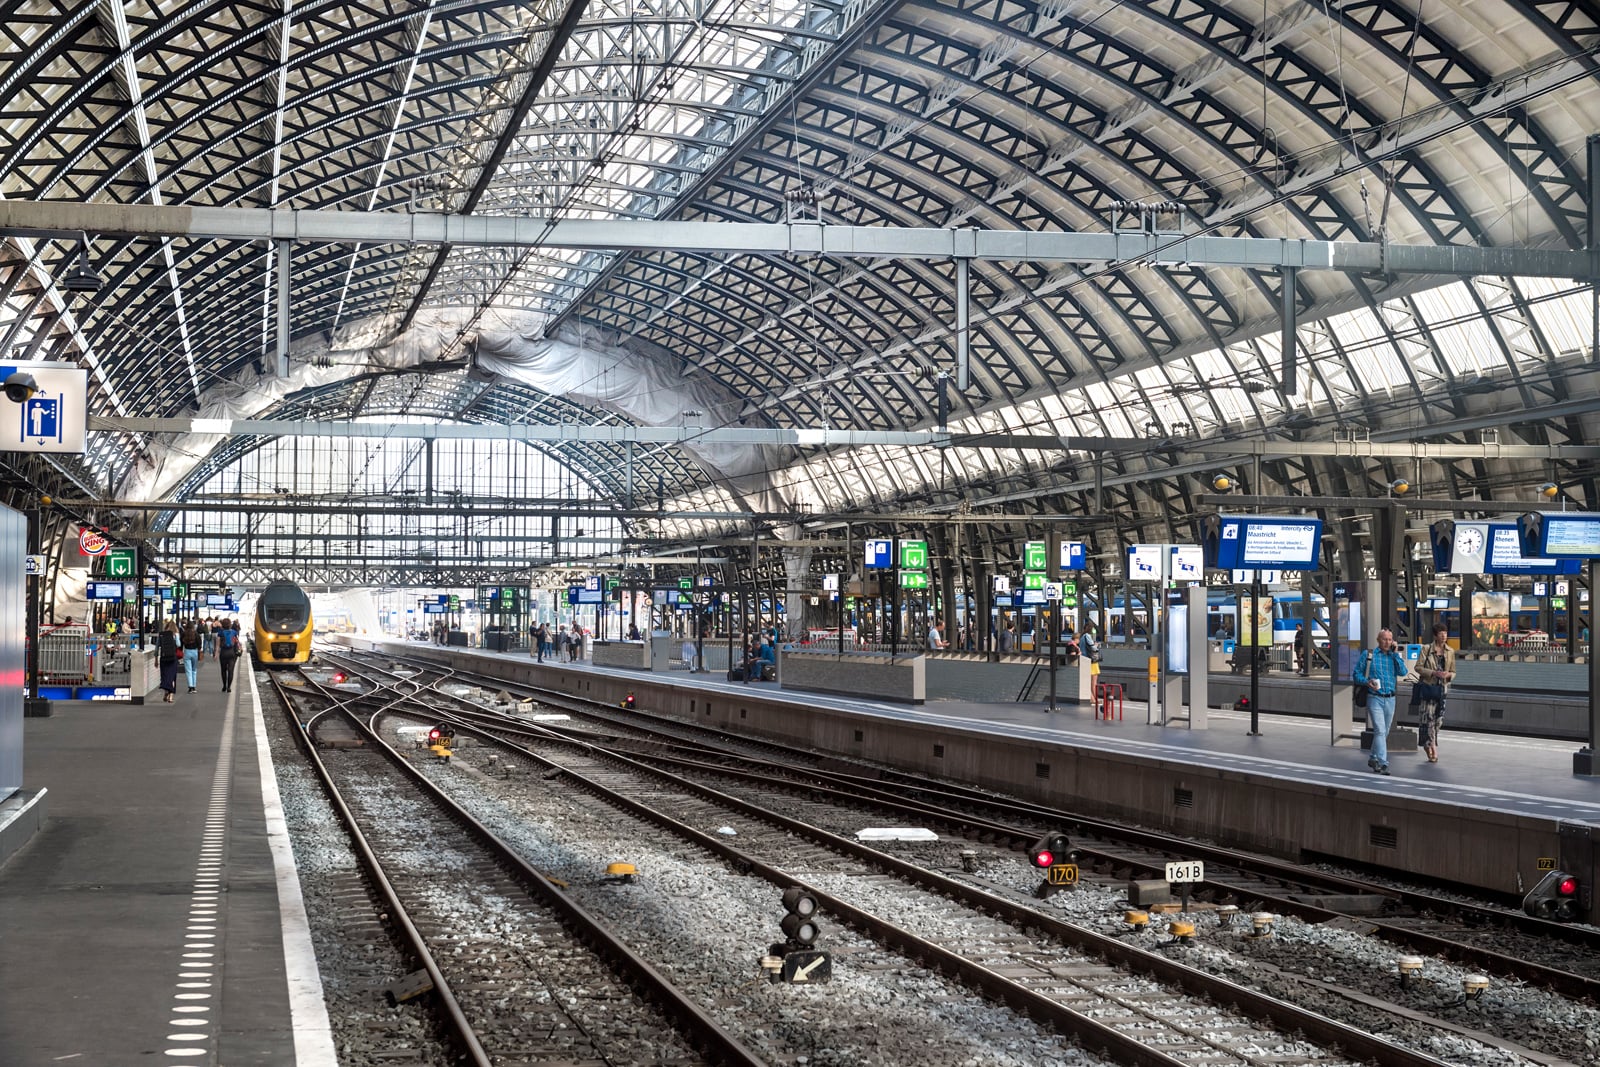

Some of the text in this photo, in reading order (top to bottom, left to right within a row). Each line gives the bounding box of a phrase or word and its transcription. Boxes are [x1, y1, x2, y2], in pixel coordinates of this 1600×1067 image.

[84, 539, 105, 548] KING
[1239, 571, 1245, 582] J
[1268, 571, 1274, 583] J
[1559, 586, 1566, 594] R
[694, 594, 701, 602] V
[1540, 860, 1551, 868] 172
[1052, 867, 1074, 881] 170
